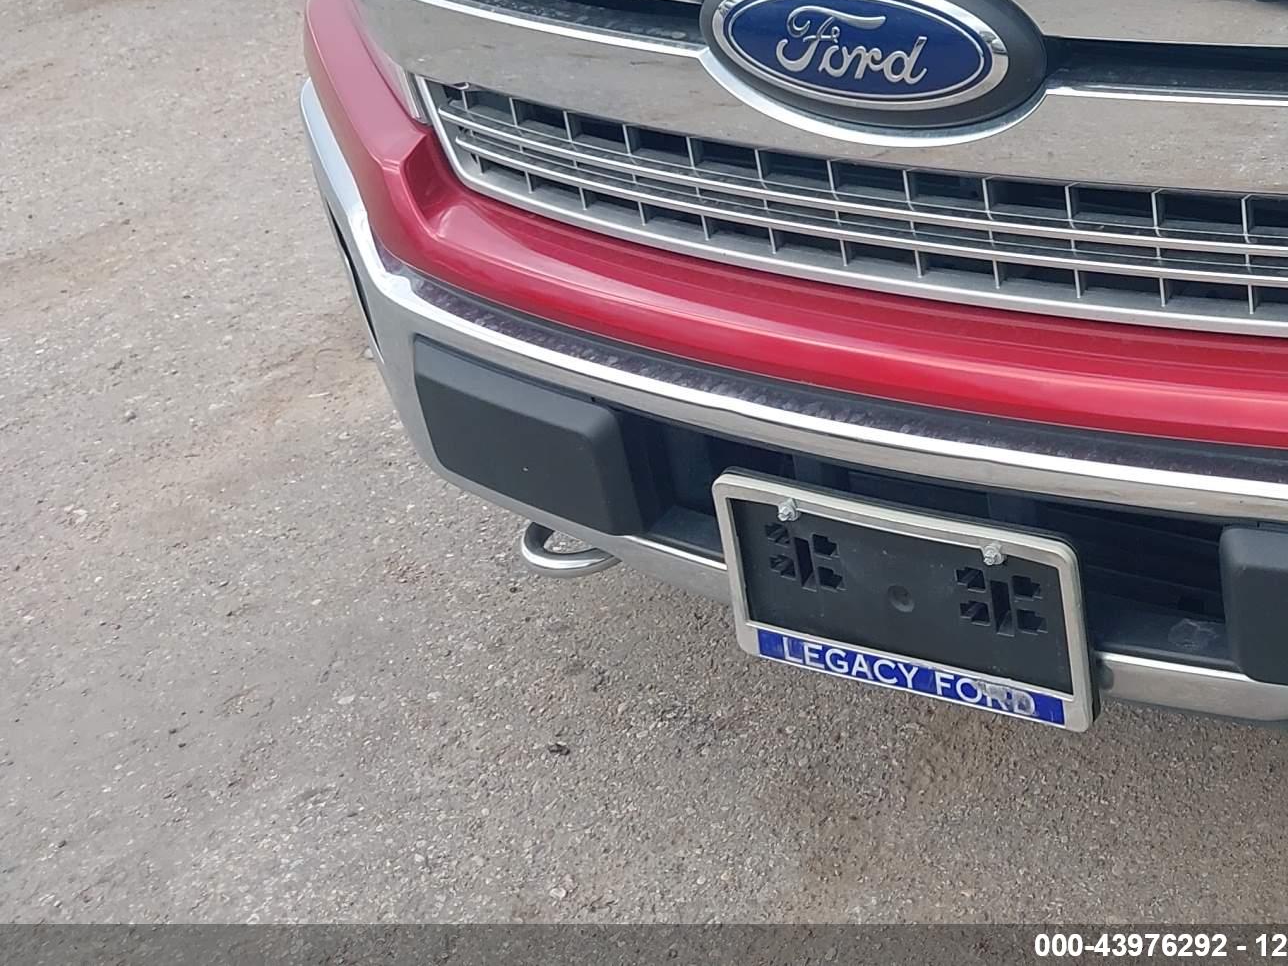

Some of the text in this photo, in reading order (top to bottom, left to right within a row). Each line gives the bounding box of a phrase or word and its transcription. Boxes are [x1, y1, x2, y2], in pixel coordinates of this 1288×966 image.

[775, 4, 928, 85] Ford
[781, 635, 1038, 718] LEGACY FORD
